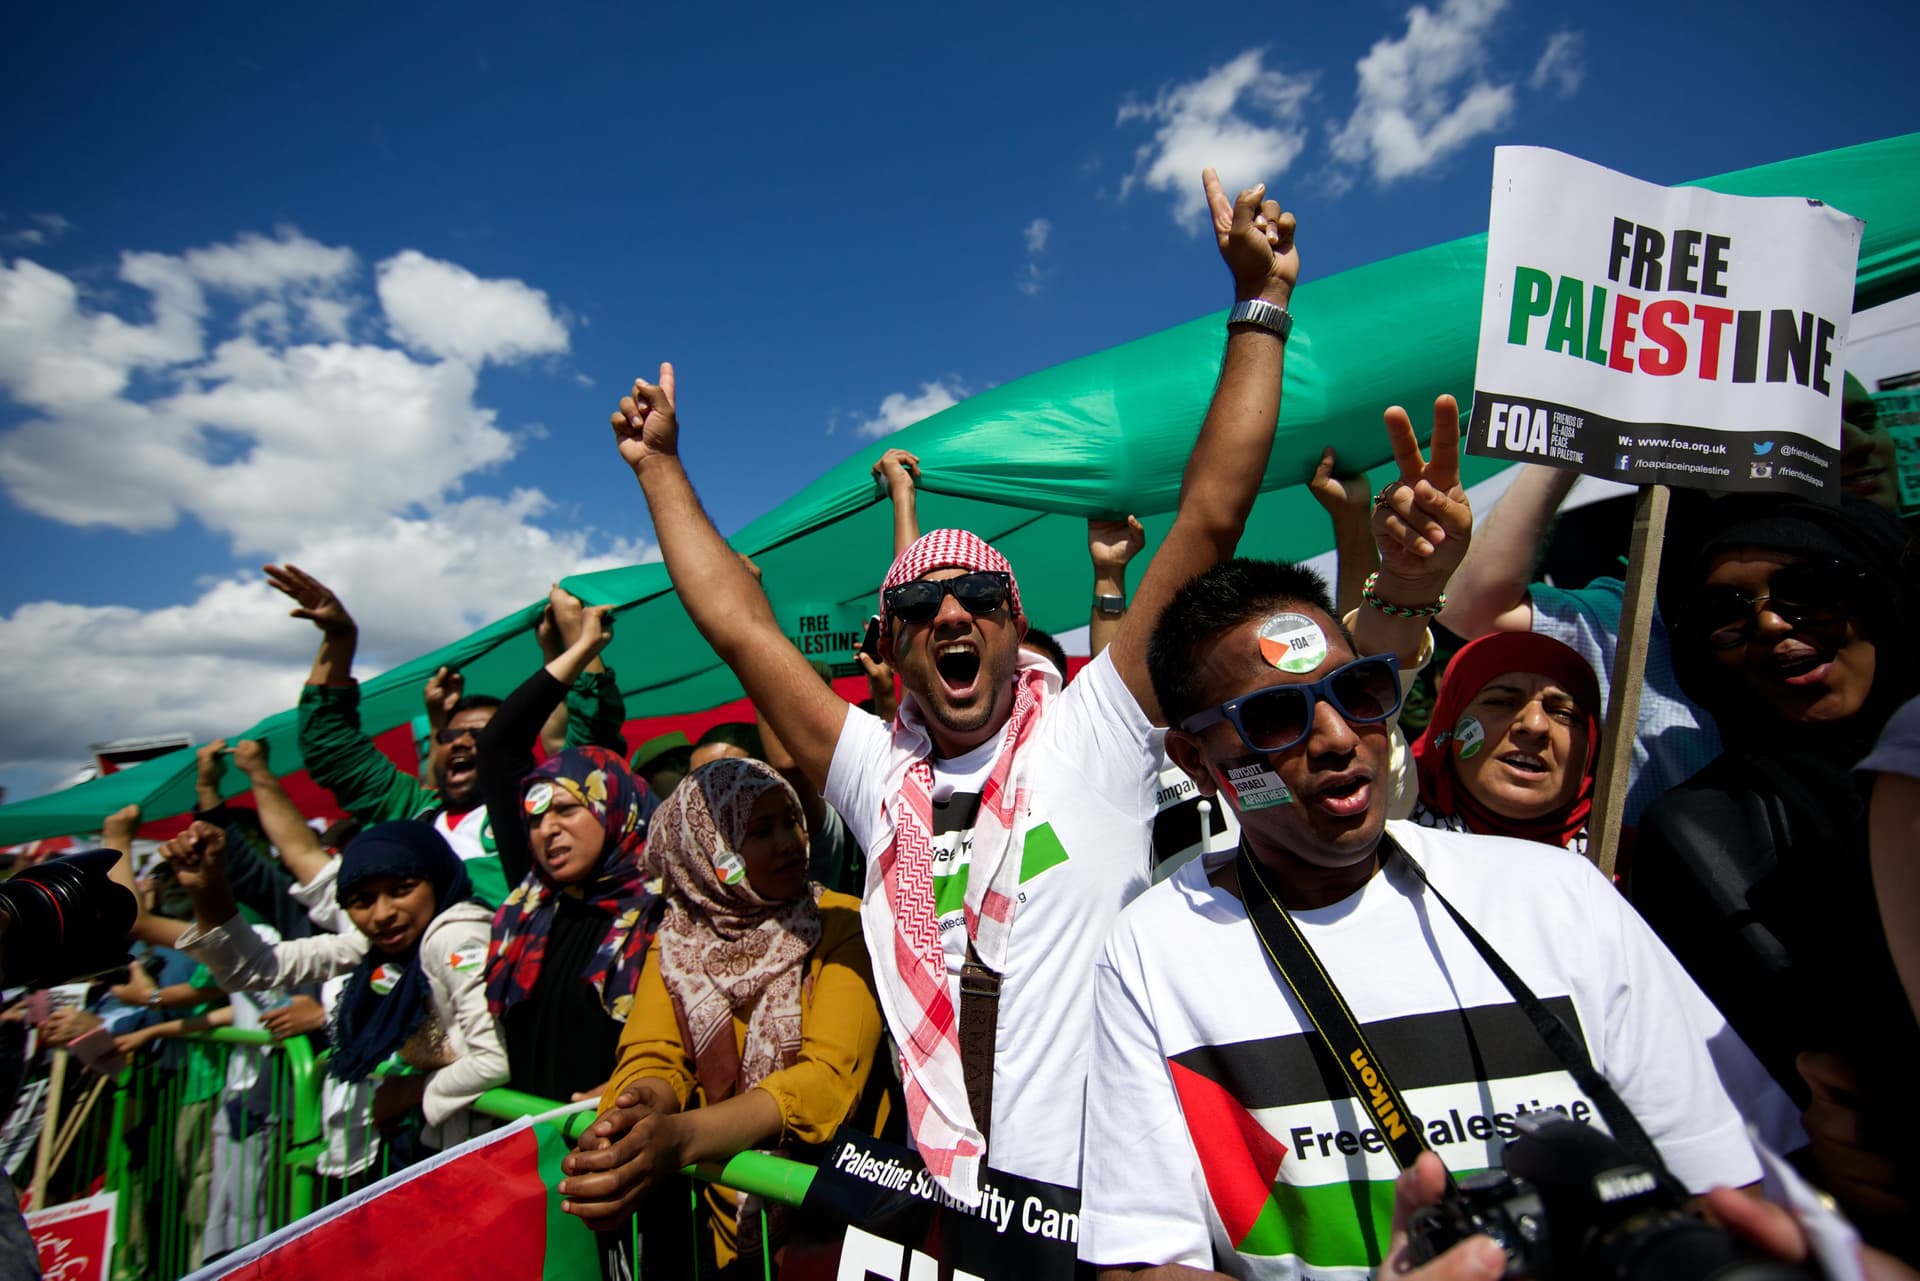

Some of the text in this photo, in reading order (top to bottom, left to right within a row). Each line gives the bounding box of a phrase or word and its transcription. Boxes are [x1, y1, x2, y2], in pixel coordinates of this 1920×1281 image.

[1608, 217, 1731, 298] FREE
[1507, 266, 1836, 397] PALESTINE
[1486, 402, 1548, 456] FOA
[1553, 411, 1584, 429] FRIENDS OF
[1550, 434, 1569, 448] PEACE
[1618, 435, 1727, 455] W: www.foa.org.uk
[1549, 446, 1585, 464] IN PALESTINE
[1634, 456, 1730, 476] /foapeaceinpalestine
[799, 614, 830, 633] FREE
[788, 631, 860, 655] LESTINE
[1289, 636, 1310, 651] FOA
[1227, 763, 1264, 780] BOYCOTT
[1234, 777, 1267, 793] ISRAELI
[1243, 788, 1290, 805] APARTHEID
[1350, 1048, 1408, 1141] Nikon
[1290, 1126, 1386, 1162] Free
[835, 1142, 912, 1193] Palestine
